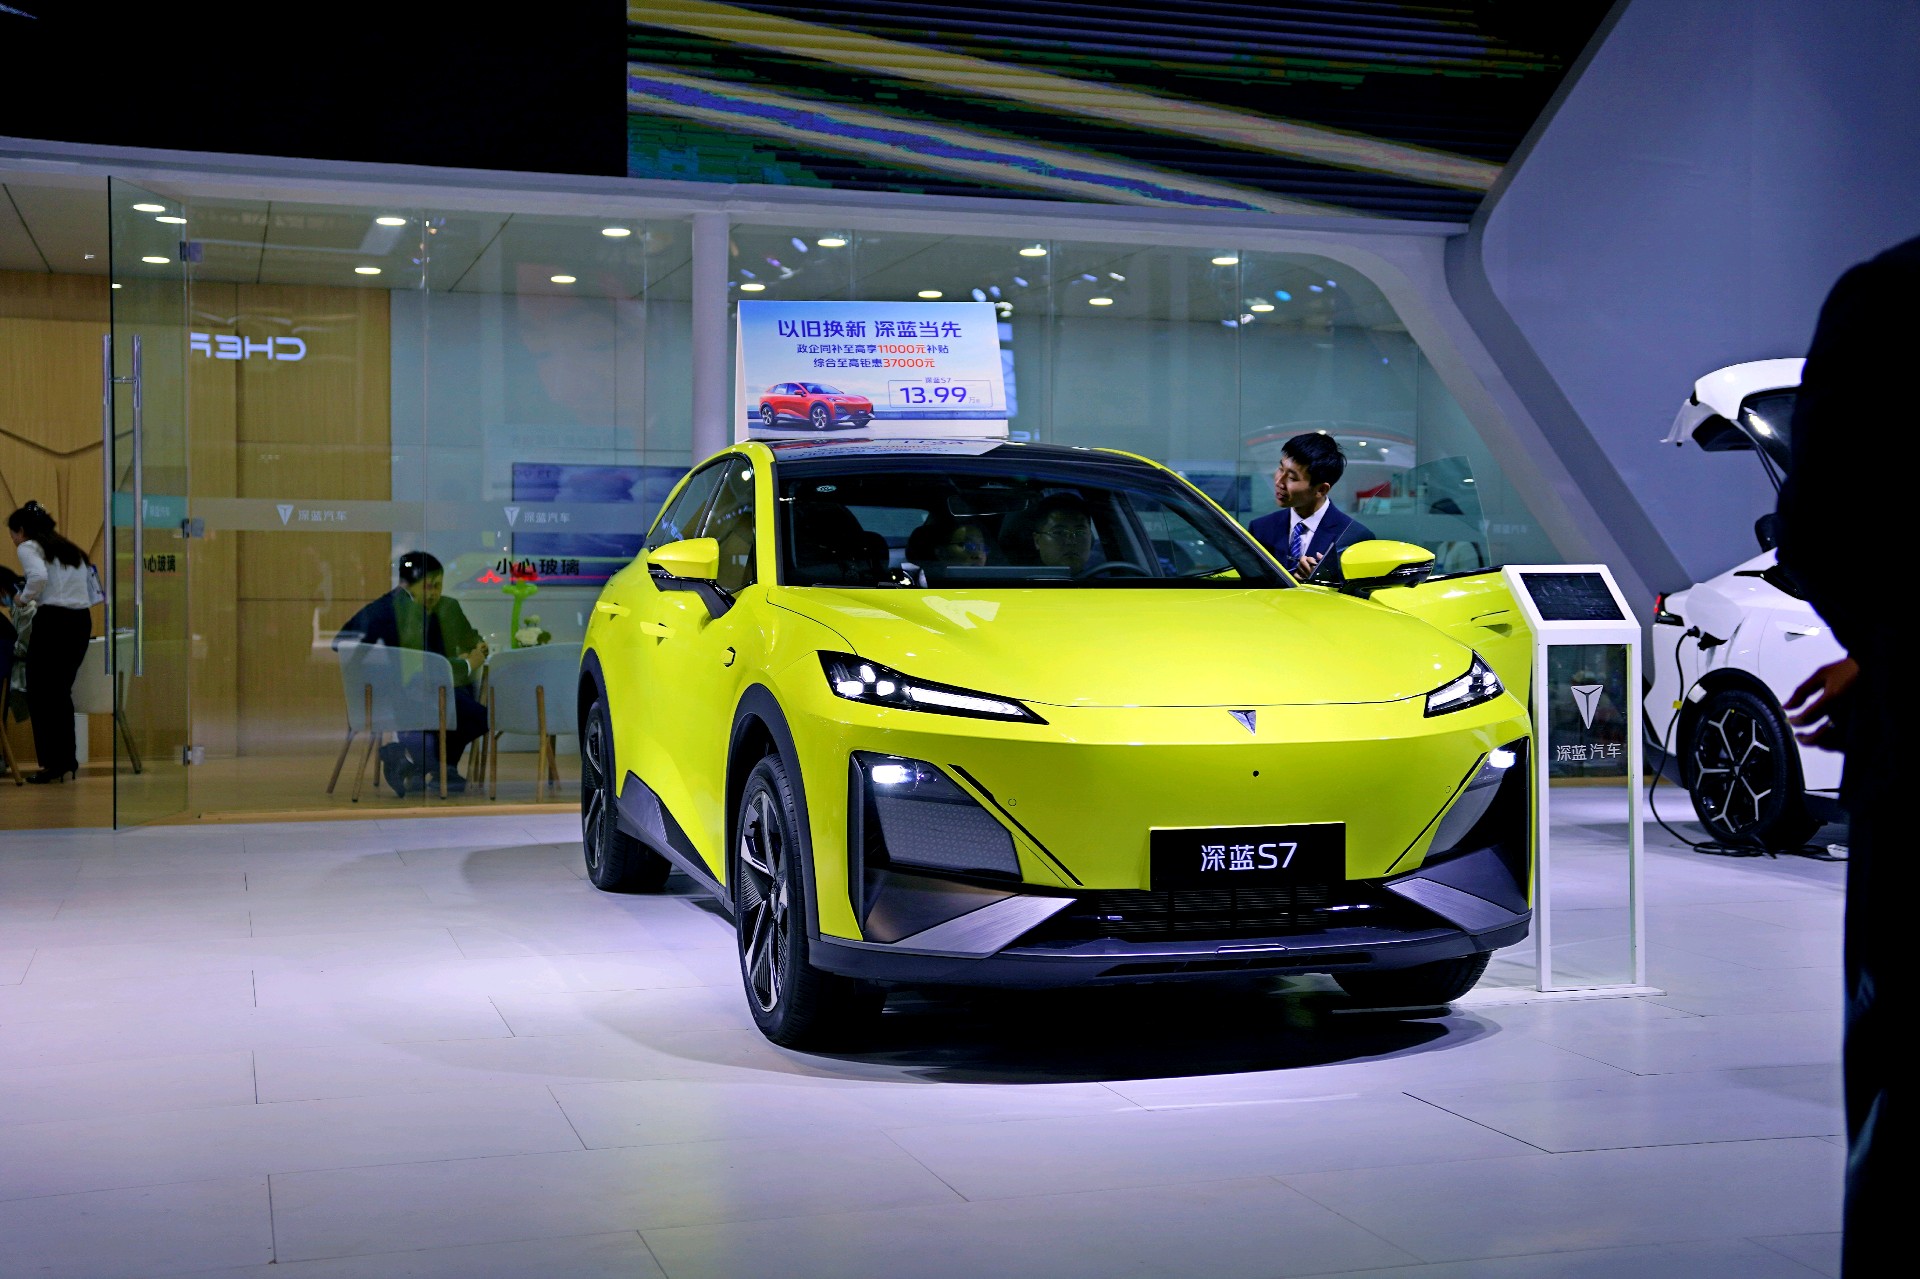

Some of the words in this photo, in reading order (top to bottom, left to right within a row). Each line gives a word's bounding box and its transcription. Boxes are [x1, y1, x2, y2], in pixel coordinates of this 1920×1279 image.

[778, 319, 866, 338] 以旧换新
[875, 320, 962, 338] 深蓝当先
[797, 344, 949, 354] 政企同补至高享11000元补贴
[813, 358, 936, 368] 综合至高钜惠37000元
[899, 386, 967, 404] 13.99
[143, 554, 176, 573] 心玻璃
[496, 557, 580, 576] 小心玻璃
[1556, 742, 1622, 762] 深蓝汽车
[1200, 842, 1298, 872] 深蓝S7
